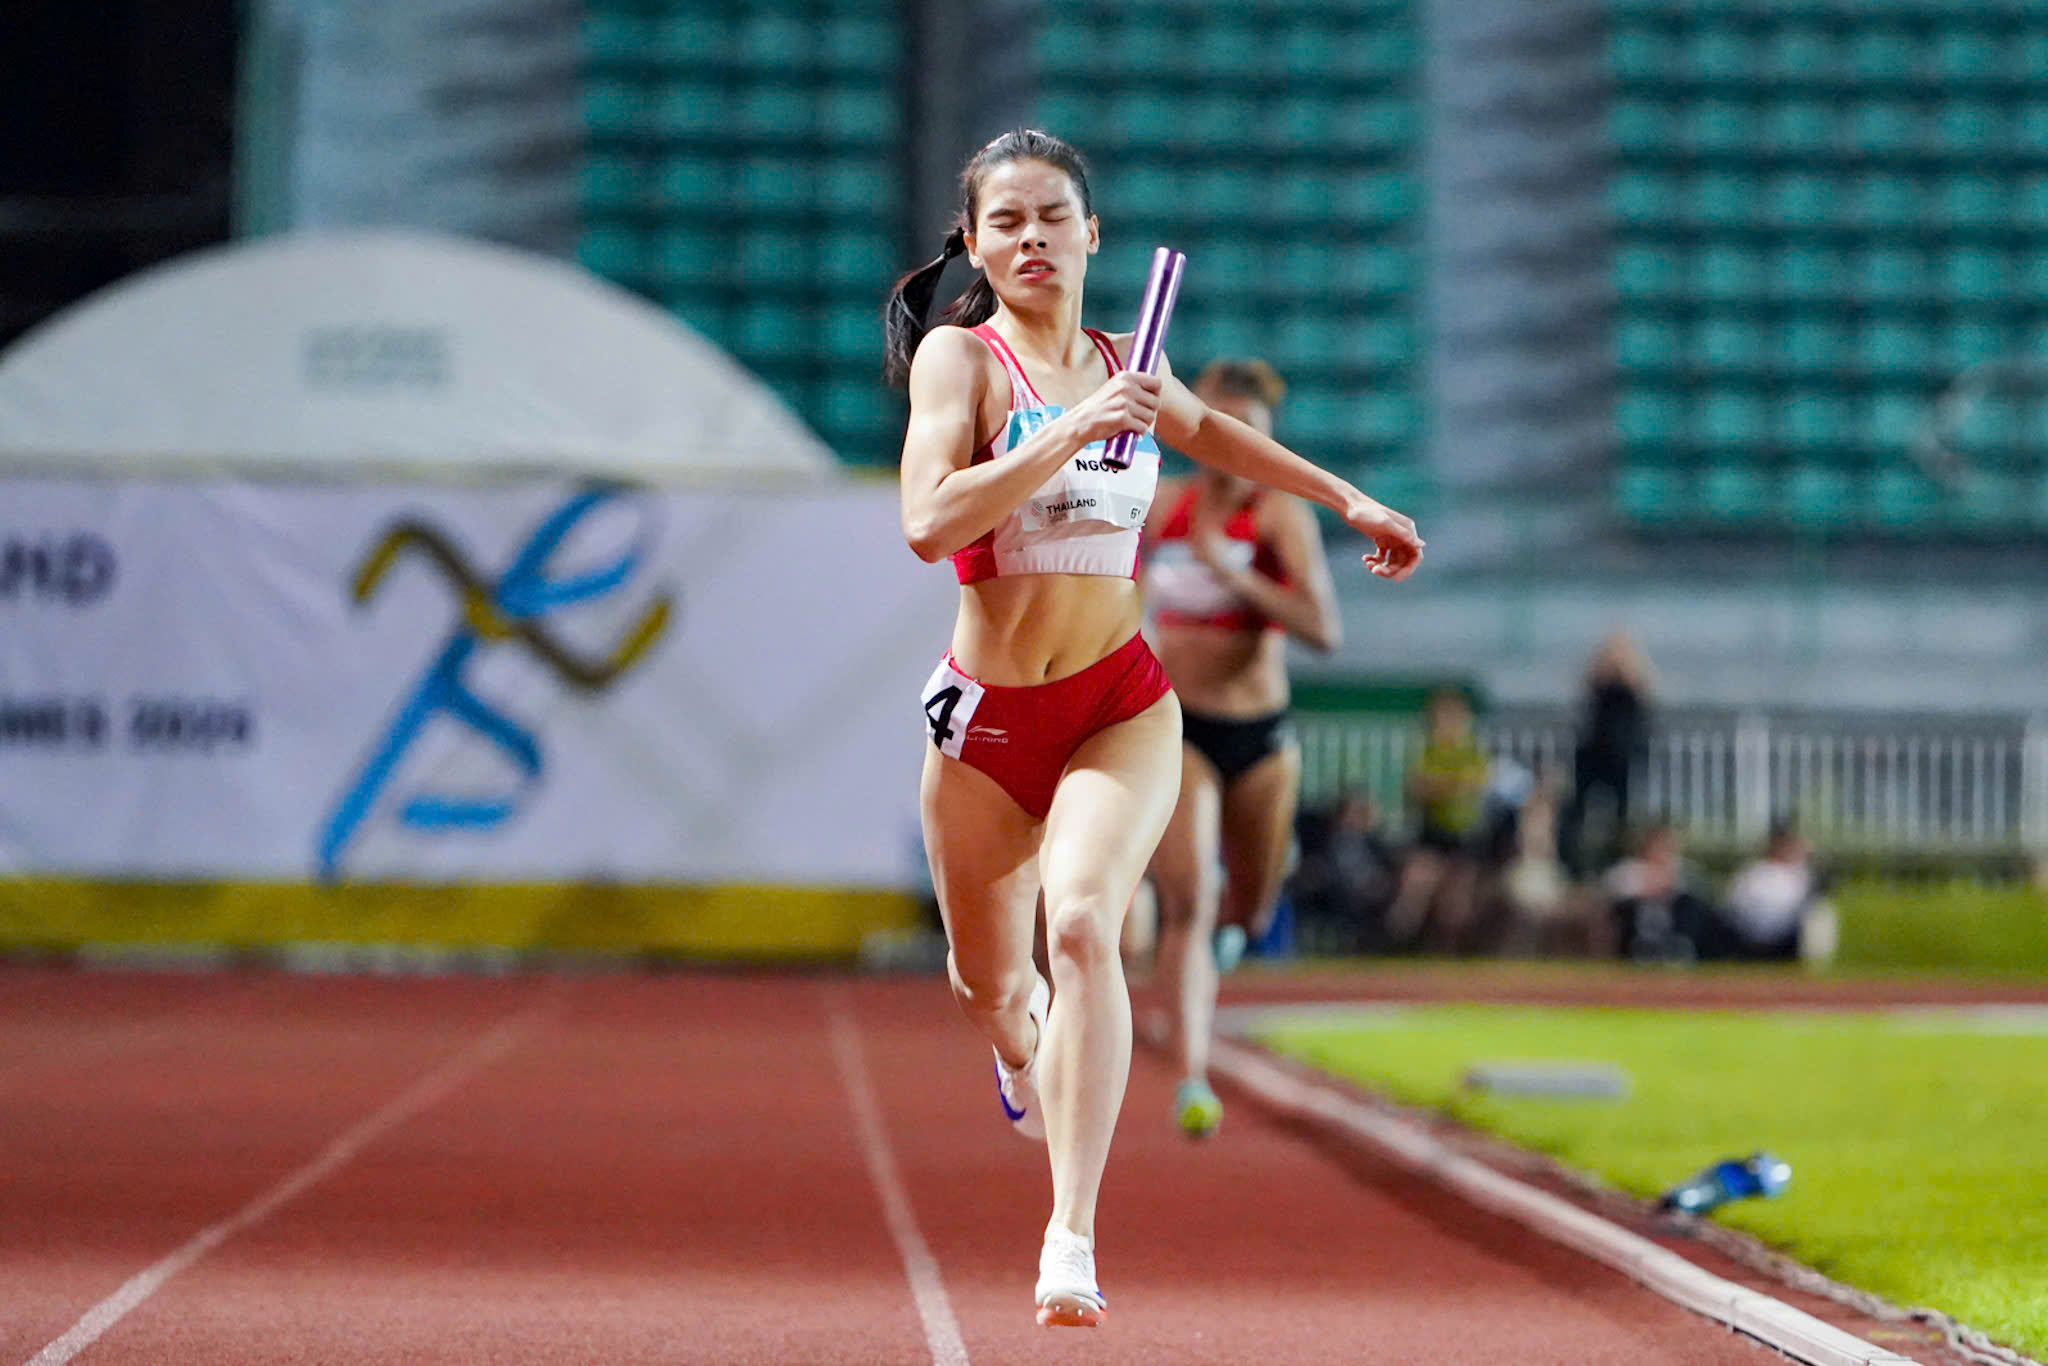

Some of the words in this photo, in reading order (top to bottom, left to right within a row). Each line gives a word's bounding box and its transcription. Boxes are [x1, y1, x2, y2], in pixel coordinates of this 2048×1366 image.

[1075, 458, 1119, 474] NGO
[1046, 498, 1096, 516] THAILAND
[925, 685, 963, 750] 4
